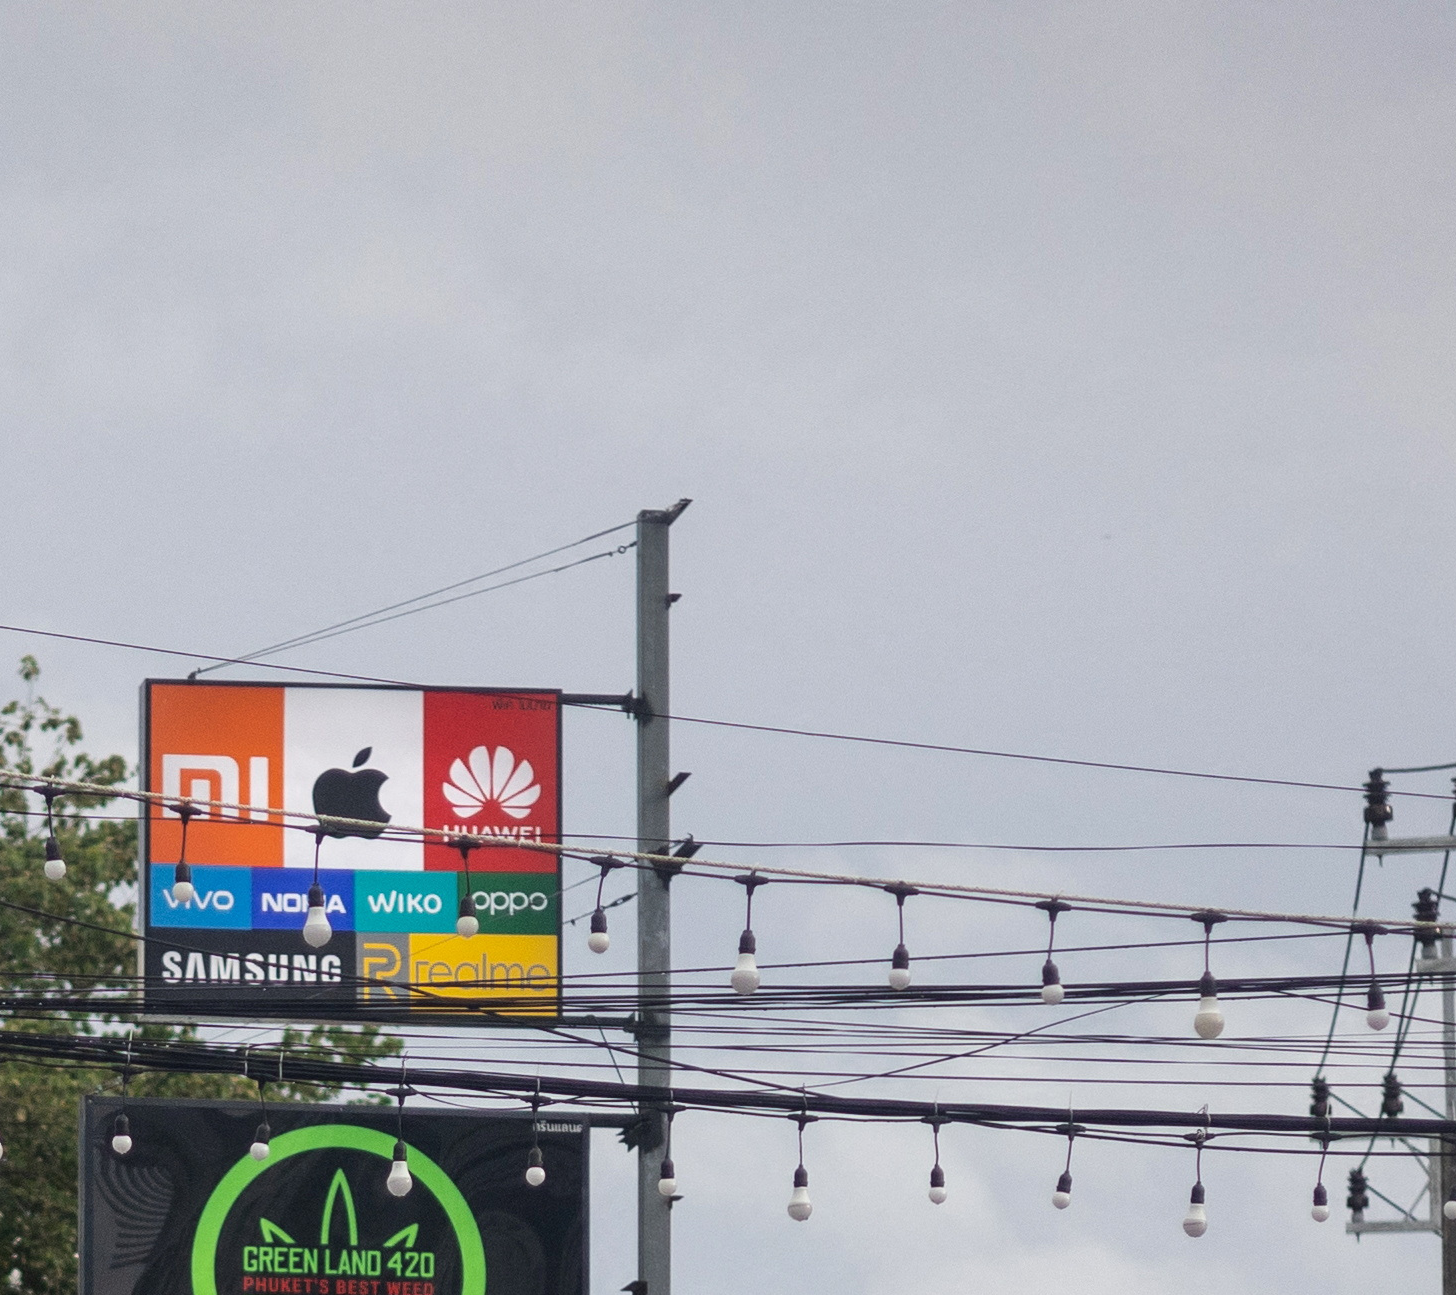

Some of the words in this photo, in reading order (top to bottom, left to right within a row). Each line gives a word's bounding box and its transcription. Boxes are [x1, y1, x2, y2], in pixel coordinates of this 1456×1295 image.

[161, 950, 342, 984] SAMSUNG
[243, 1246, 317, 1274] GREEN
[324, 1249, 382, 1276] LAND
[387, 1252, 435, 1278] 420
[242, 1276, 329, 1295] PHUKET'S
